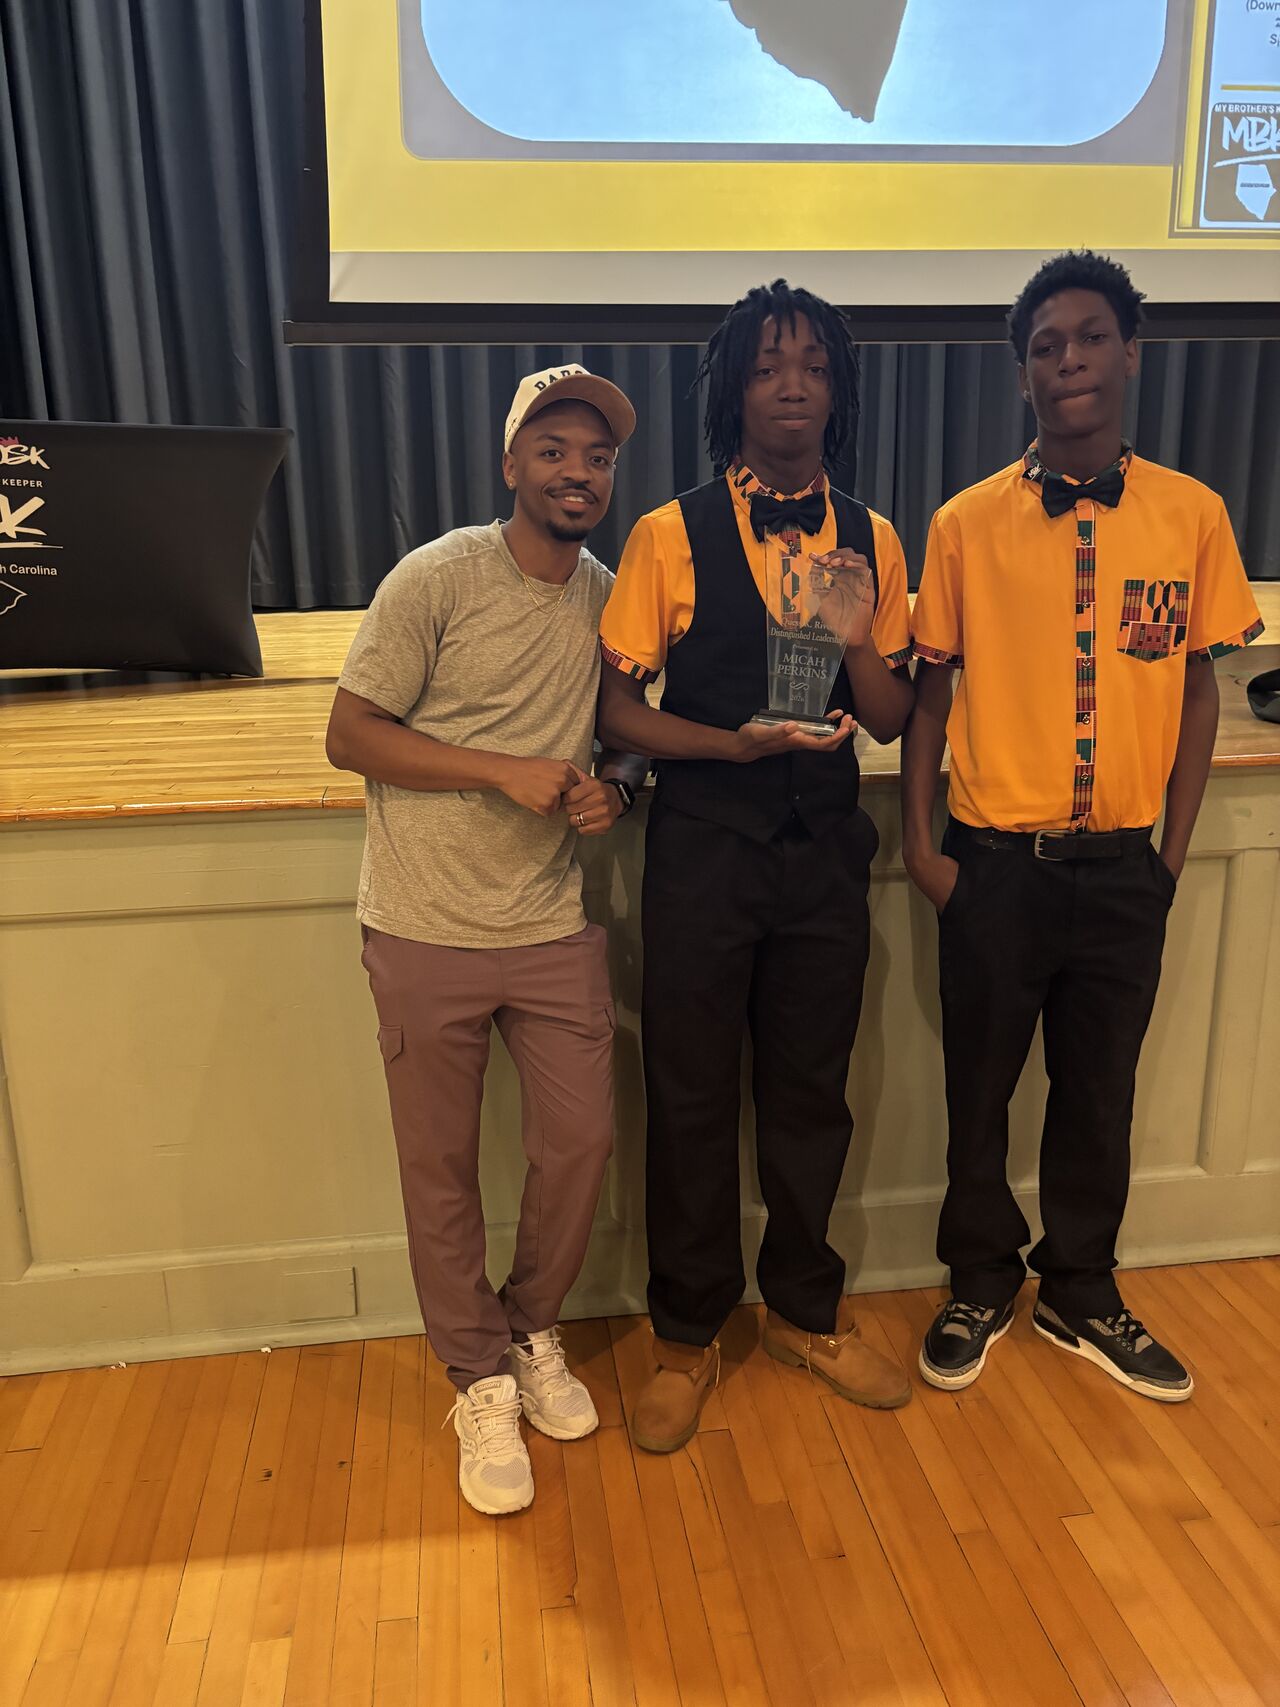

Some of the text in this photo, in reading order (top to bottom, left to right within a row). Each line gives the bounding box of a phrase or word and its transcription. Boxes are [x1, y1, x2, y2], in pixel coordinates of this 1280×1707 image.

[1214, 104, 1227, 113] MY
[2, 478, 43, 488] KEEPER
[9, 563, 58, 576] Carolina
[783, 652, 825, 667] MICAH
[777, 664, 827, 680] PERKINS
